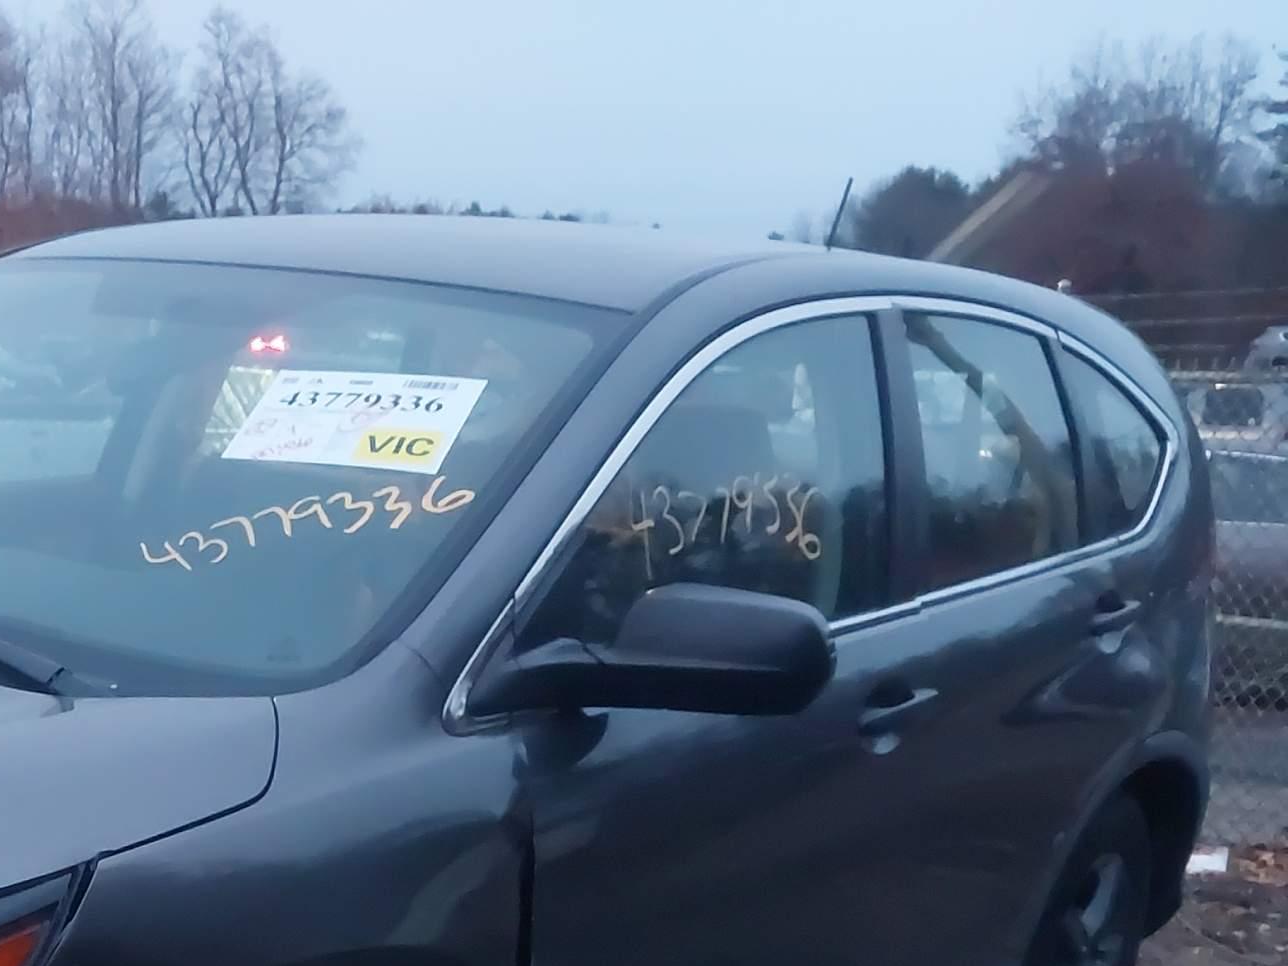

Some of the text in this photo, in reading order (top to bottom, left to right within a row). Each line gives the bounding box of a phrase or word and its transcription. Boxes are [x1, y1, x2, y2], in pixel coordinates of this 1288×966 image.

[280, 391, 443, 413] 43779336
[368, 435, 435, 457] VIC
[140, 475, 476, 571] 43779336
